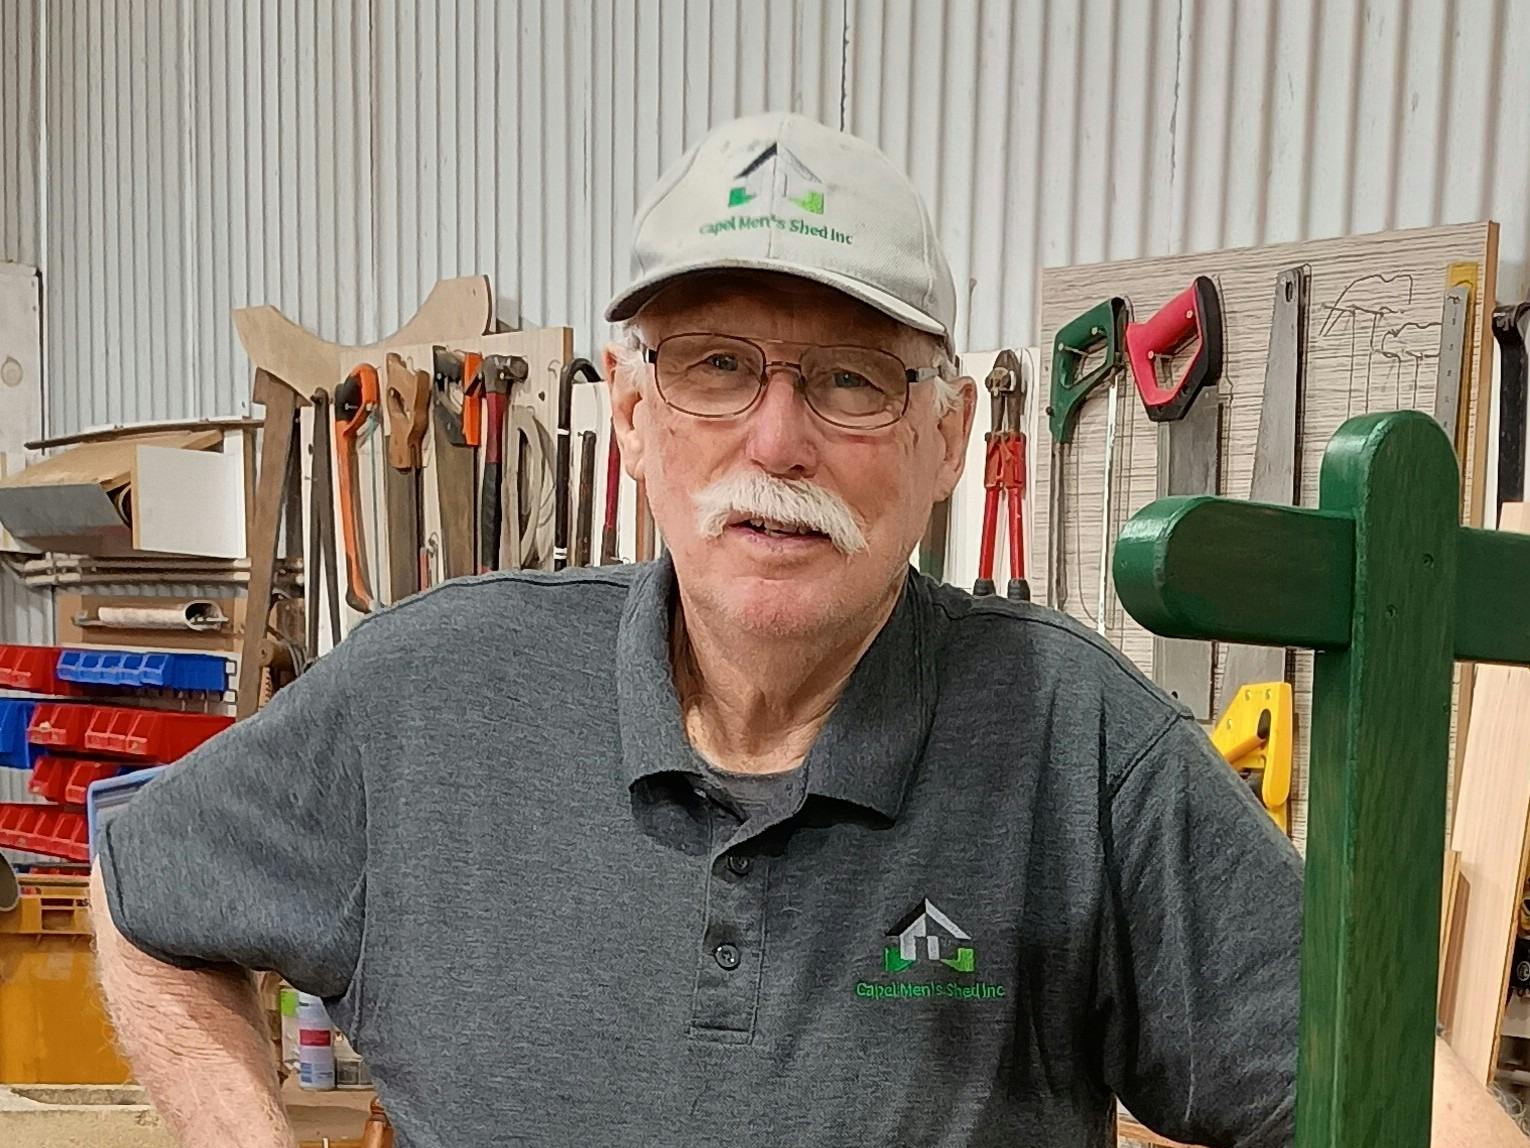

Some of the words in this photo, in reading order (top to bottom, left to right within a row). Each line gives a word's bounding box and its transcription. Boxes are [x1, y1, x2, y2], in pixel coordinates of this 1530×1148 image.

[739, 213, 786, 231] Men's
[790, 219, 828, 240] Shed
[831, 228, 853, 245] Inc
[857, 982, 898, 1000] Capel
[900, 983, 944, 998] Men's
[947, 983, 981, 998] Shed
[983, 983, 1005, 998] Inc
